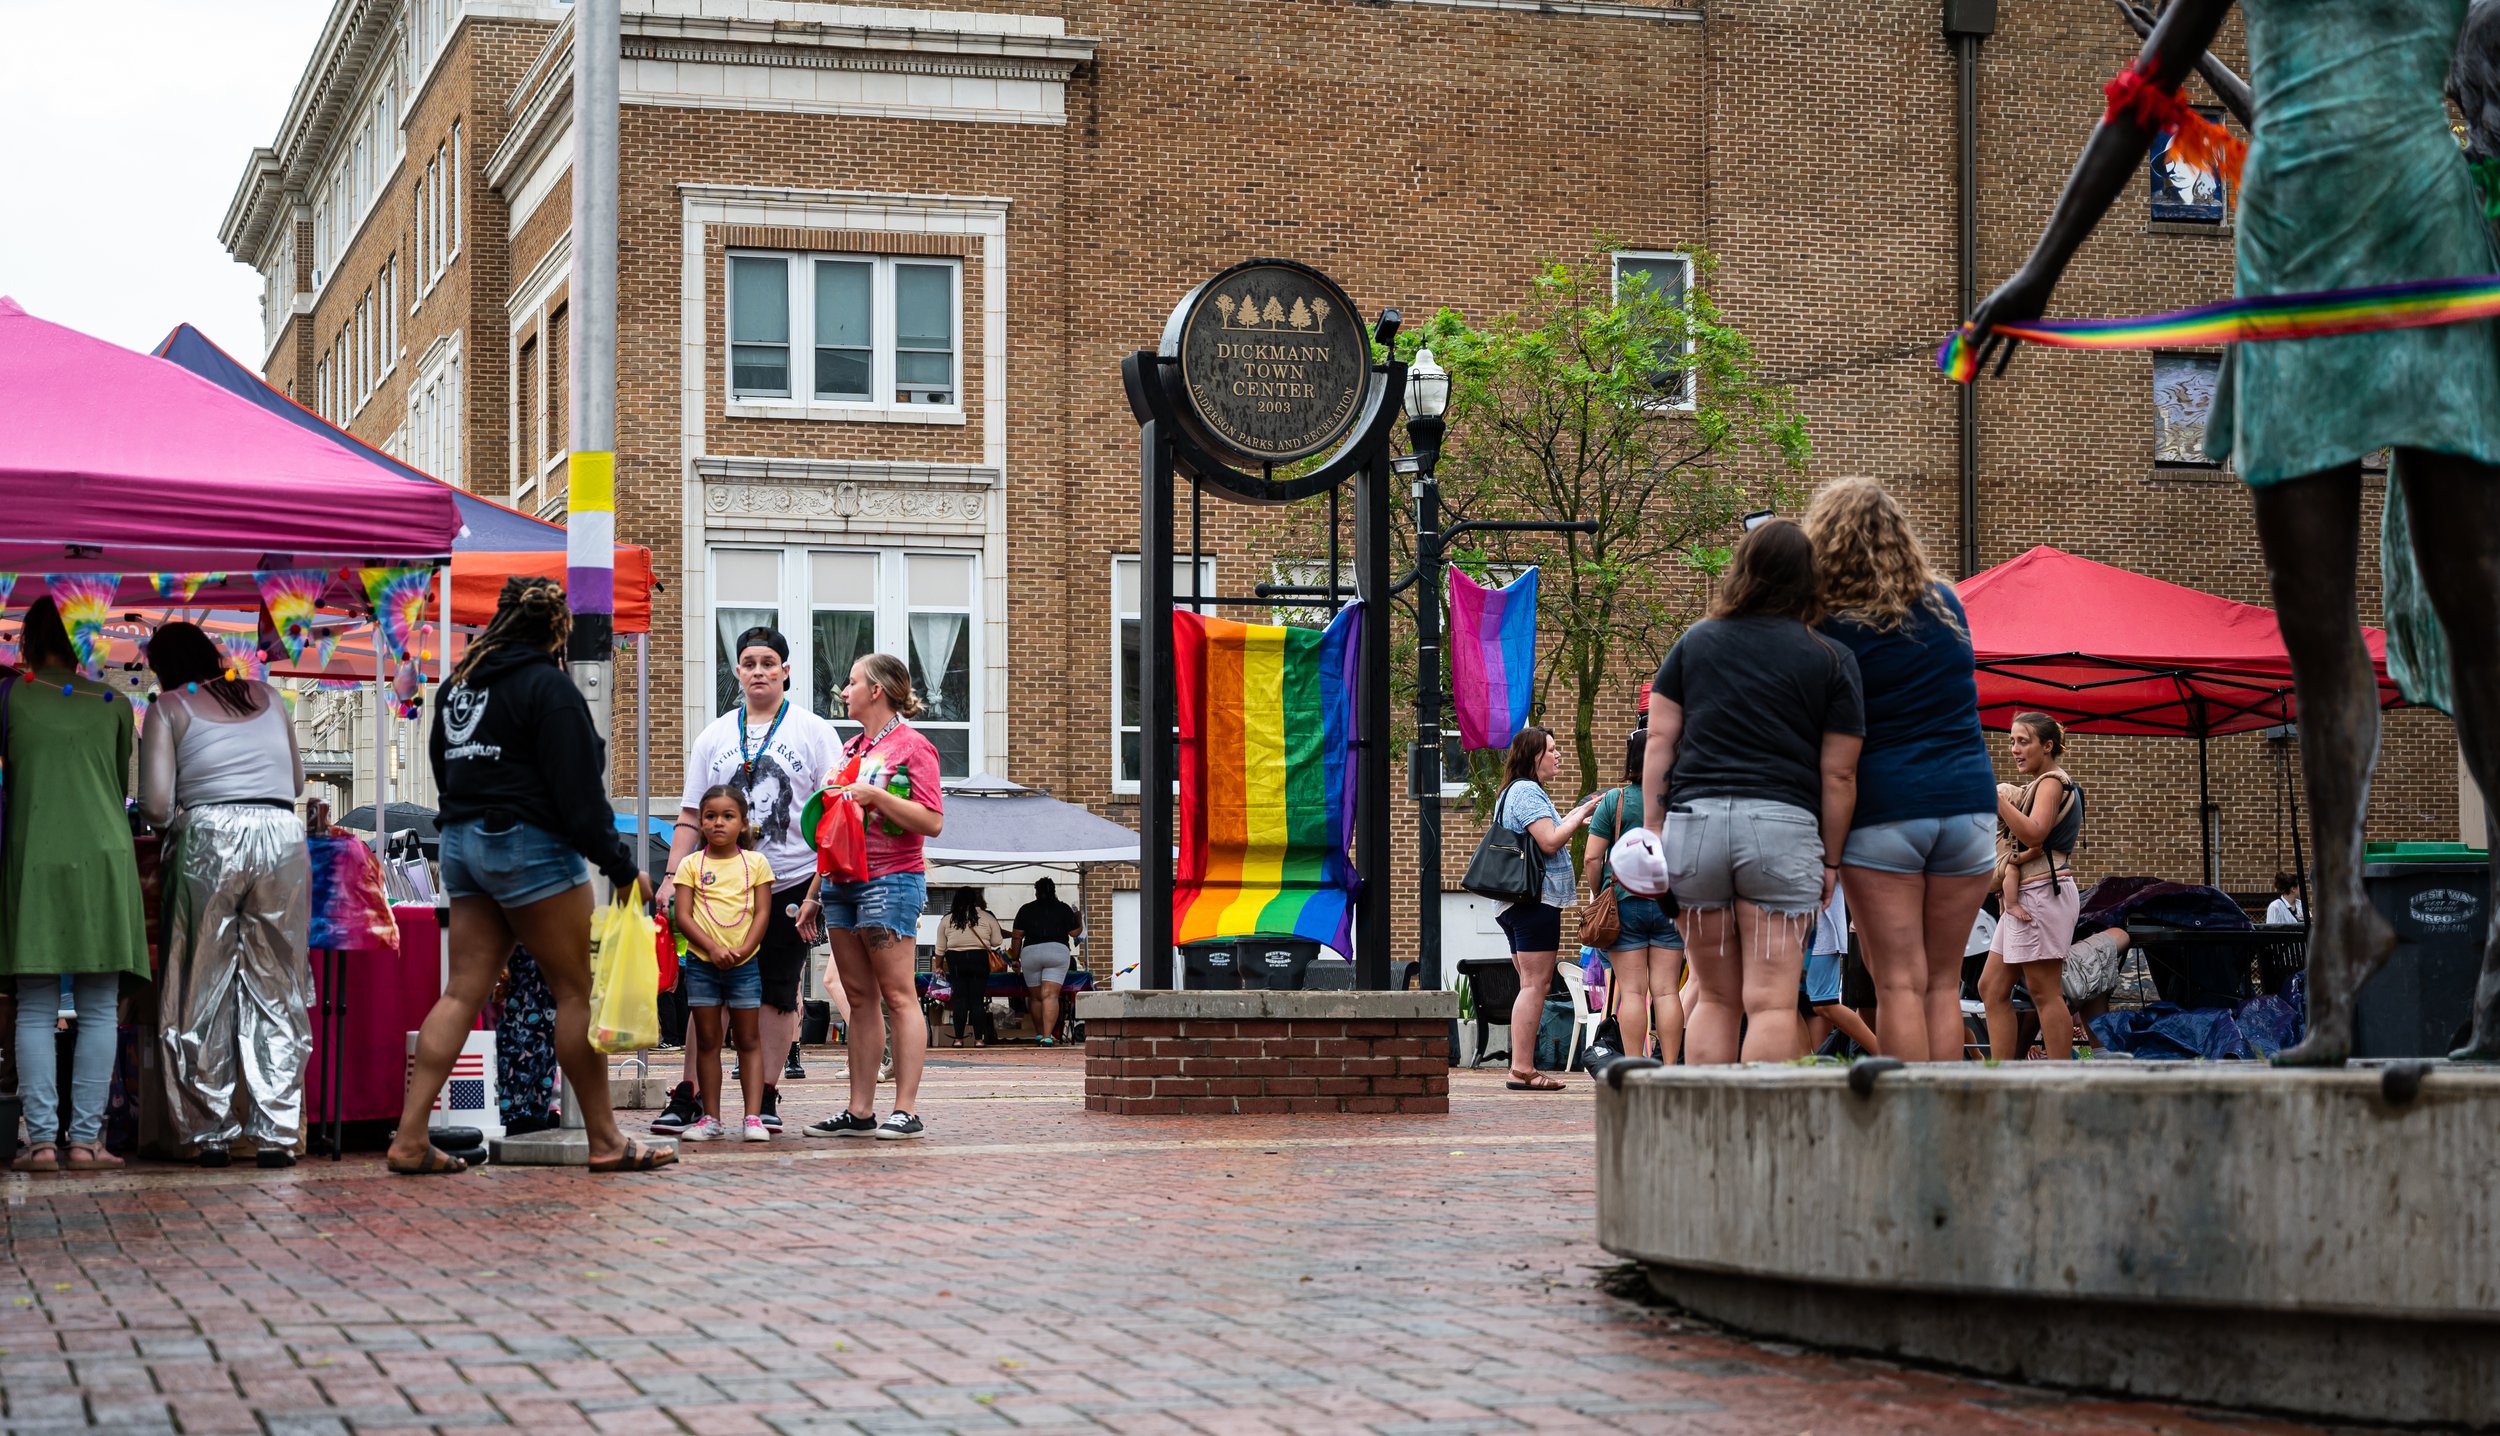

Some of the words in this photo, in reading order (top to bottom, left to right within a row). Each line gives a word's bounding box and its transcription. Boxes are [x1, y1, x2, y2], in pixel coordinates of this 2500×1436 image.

[1216, 343, 1330, 363] DICKMANN
[1243, 363, 1304, 380] TOWN
[1232, 381, 1316, 399] CENTER
[1192, 383, 1237, 437] ANDERSON
[1238, 432, 1274, 451] PARKS
[1277, 438, 1301, 451] AND
[1302, 386, 1355, 445] RECREATION
[1257, 401, 1291, 414] 2003
[777, 743, 803, 773] R&B
